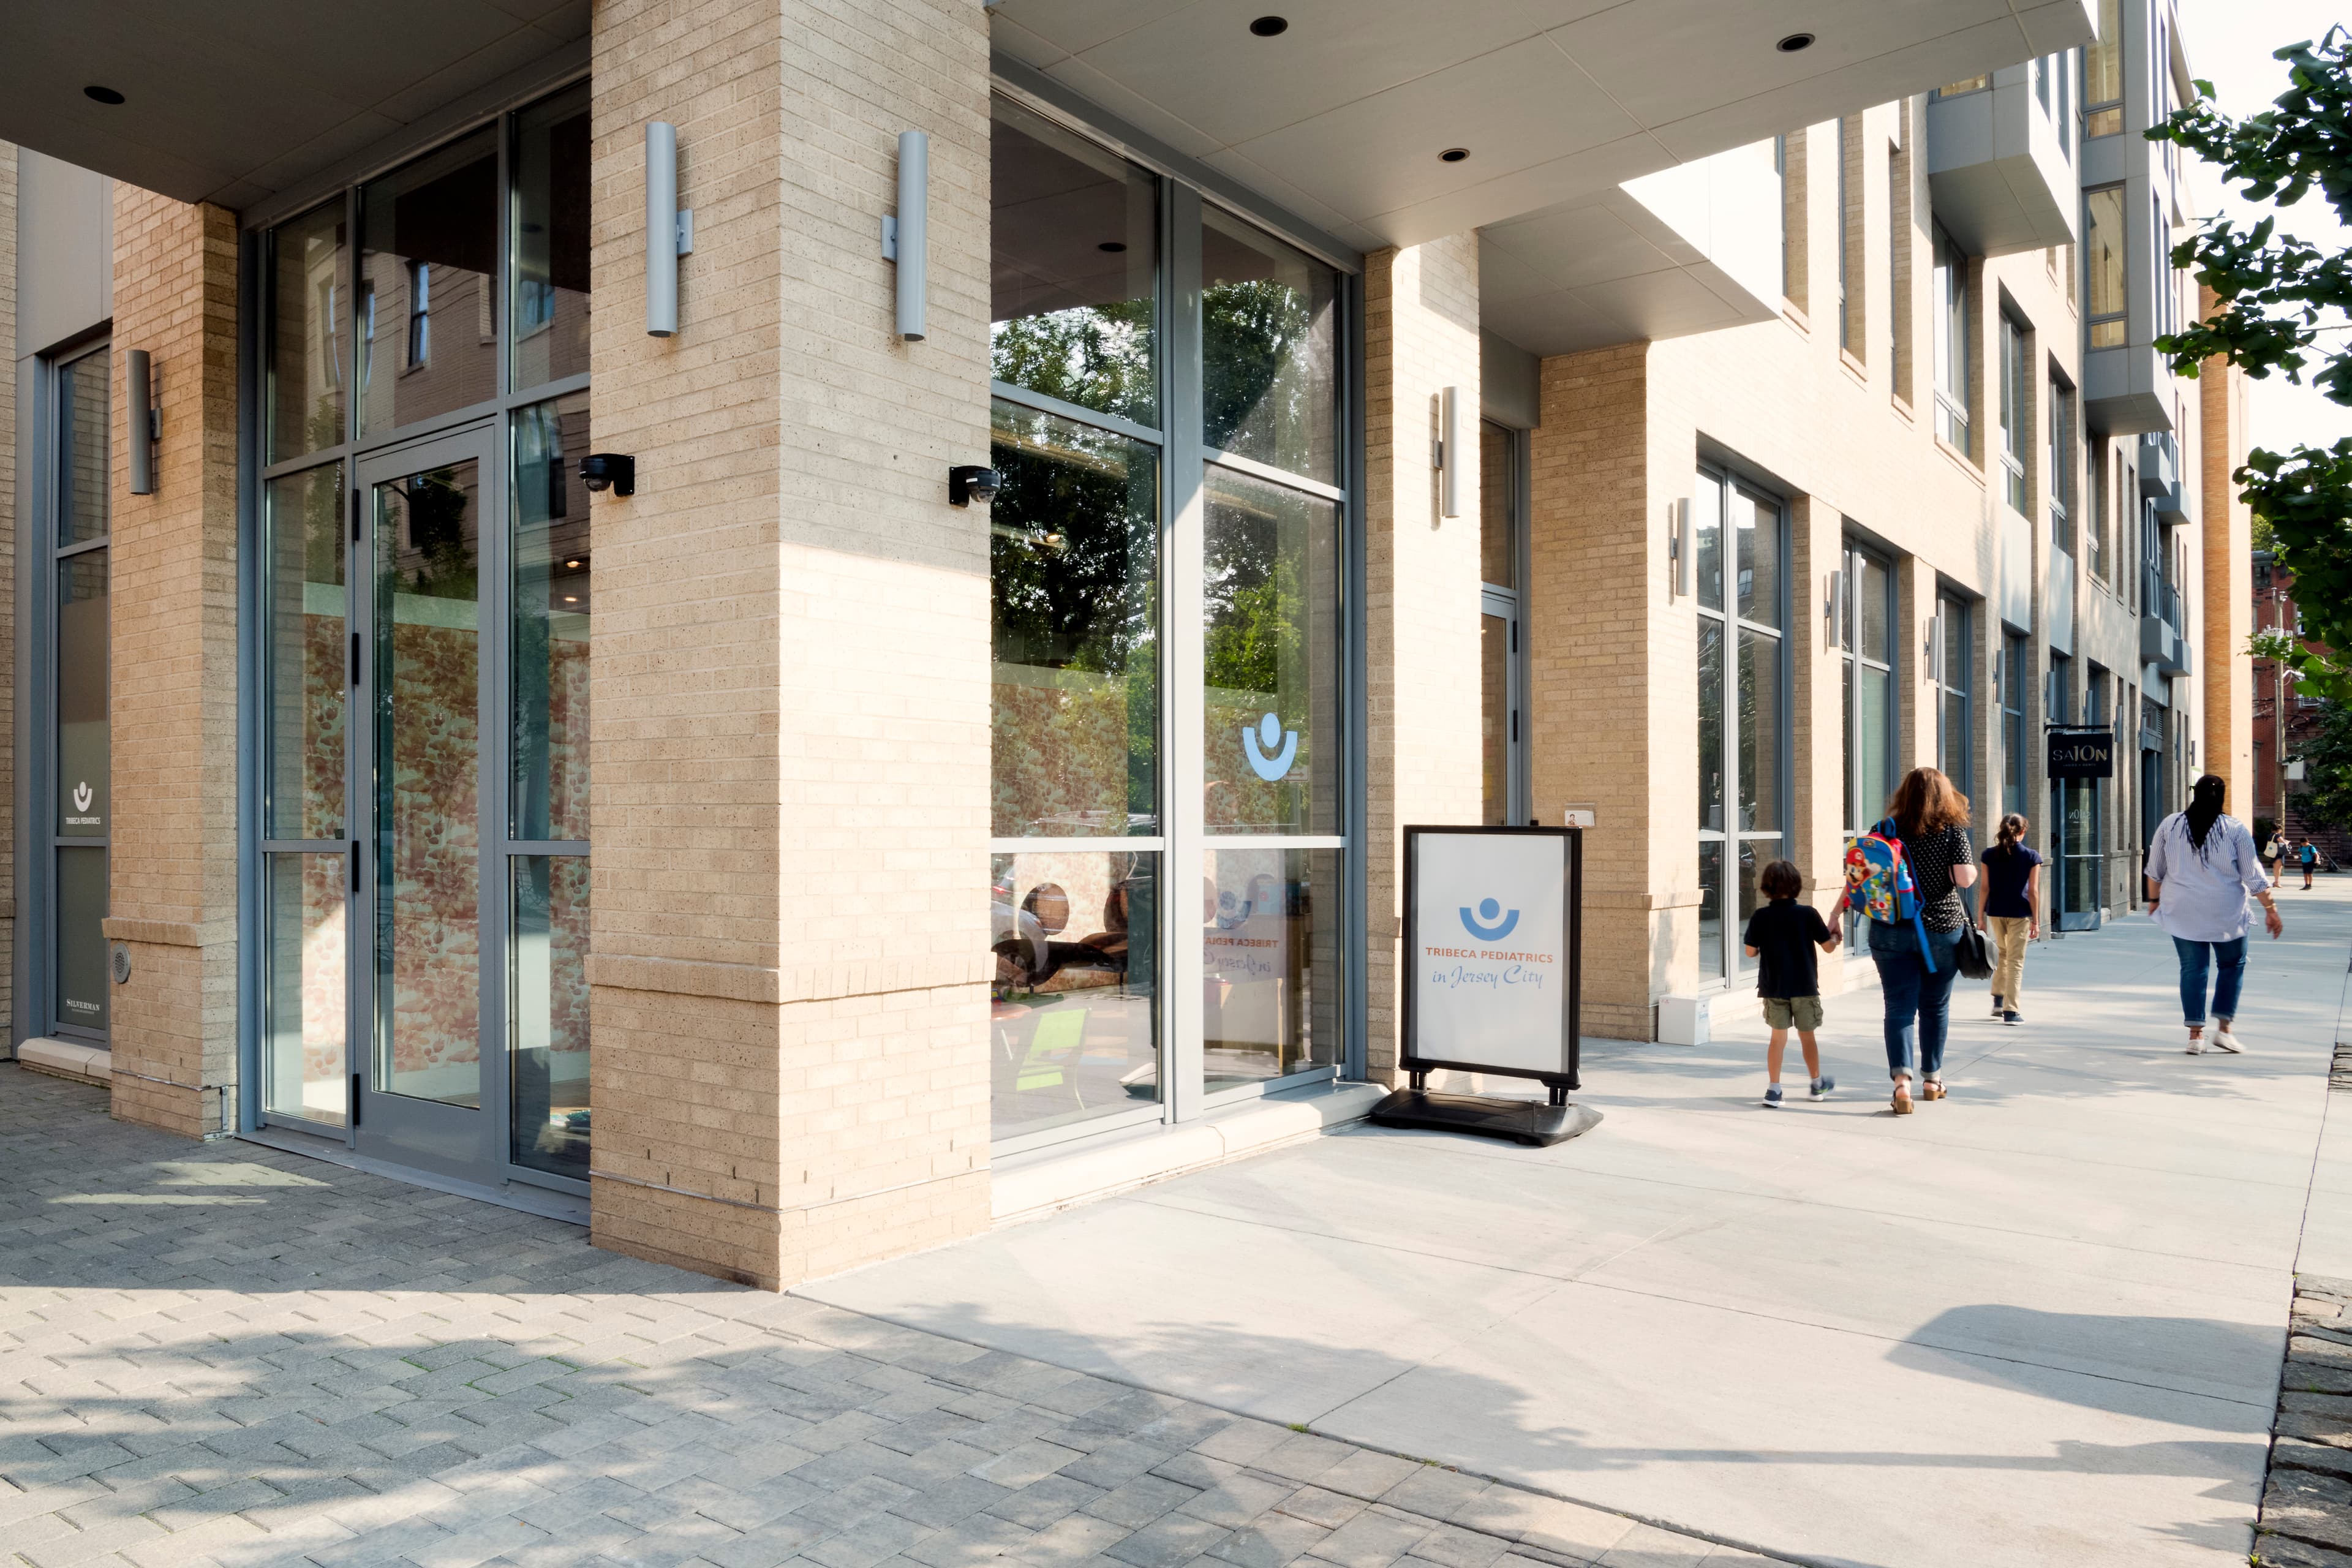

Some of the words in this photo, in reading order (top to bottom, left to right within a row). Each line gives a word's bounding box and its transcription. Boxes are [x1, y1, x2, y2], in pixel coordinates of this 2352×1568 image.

[1426, 947, 1477, 959] TRIBECA
[1481, 950, 1553, 963] PEDIATRICS
[1433, 971, 1446, 982] in
[1450, 965, 1498, 989] Jersey
[1503, 965, 1544, 989] City
